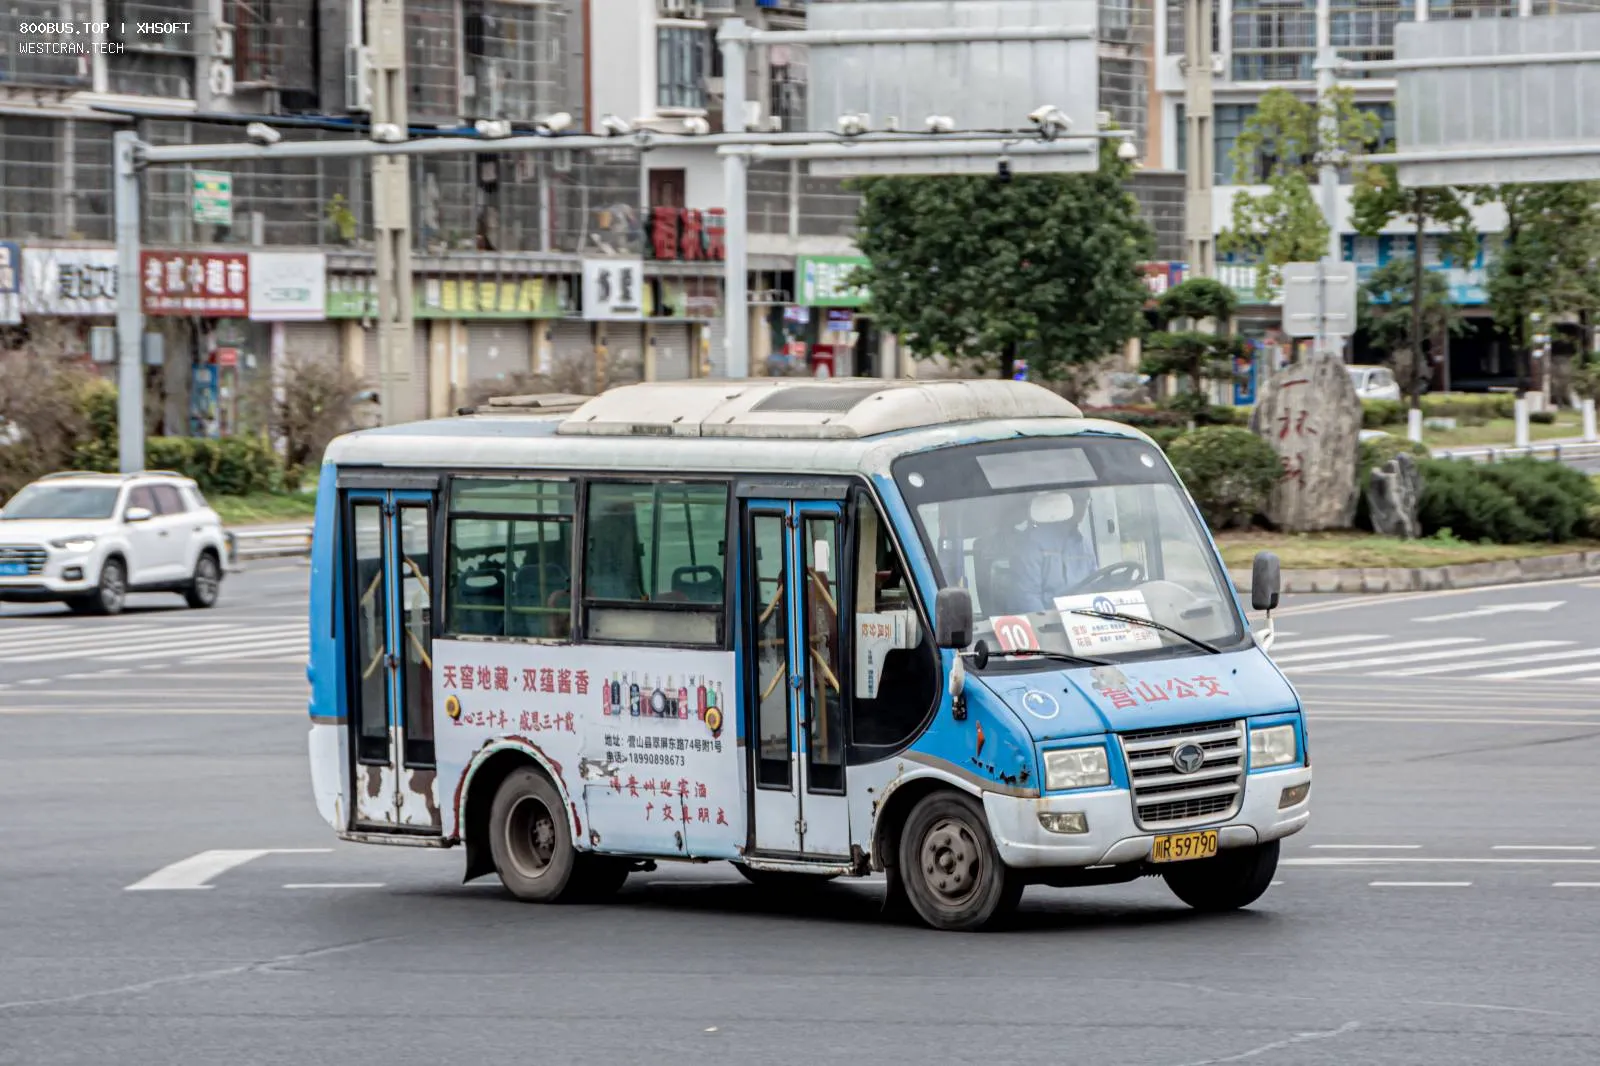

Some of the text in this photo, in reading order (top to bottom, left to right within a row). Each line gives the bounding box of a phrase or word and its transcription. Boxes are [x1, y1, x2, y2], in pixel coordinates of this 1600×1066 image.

[1001, 624, 1030, 651] 10
[1101, 675, 1229, 710] 营山公交
[645, 802, 729, 827] 广交真朋友
